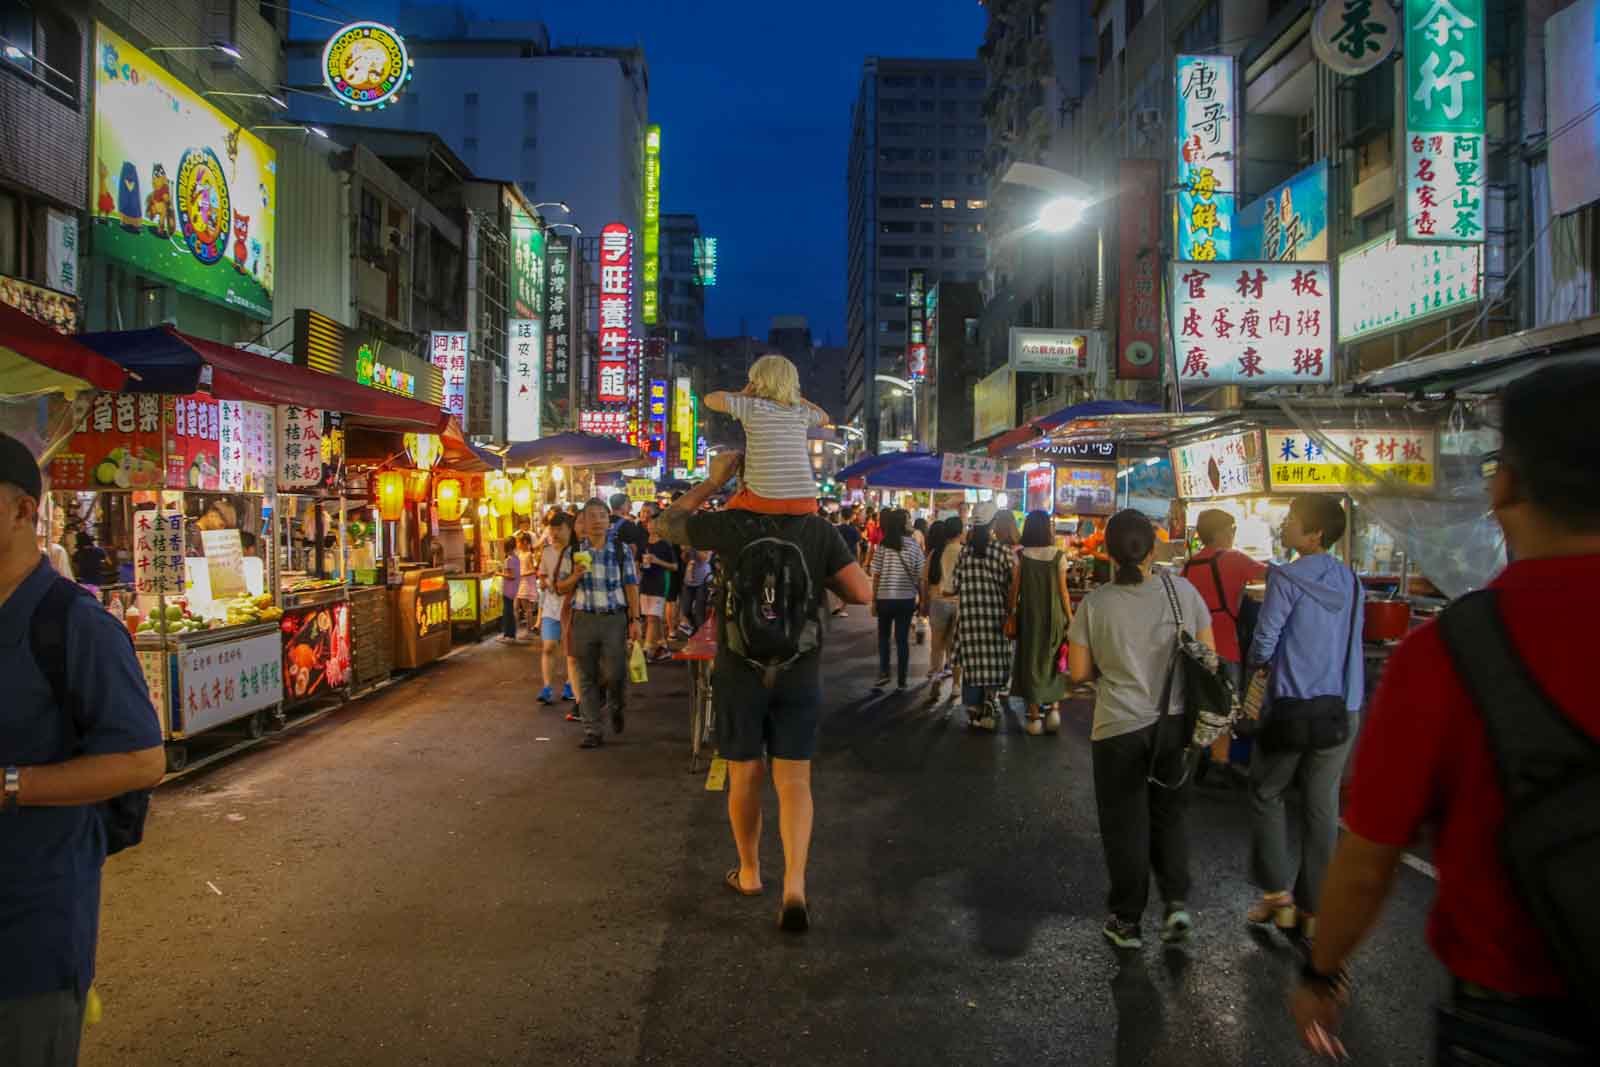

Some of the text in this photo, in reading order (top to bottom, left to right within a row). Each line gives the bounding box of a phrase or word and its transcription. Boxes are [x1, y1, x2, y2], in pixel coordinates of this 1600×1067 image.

[1182, 62, 1229, 144] 唐哥
[1411, 136, 1442, 154] 台灣
[1415, 159, 1439, 235] 名家壺
[1451, 136, 1482, 237] 阿里山茶
[1181, 268, 1322, 299] 官材板
[1180, 306, 1321, 339] 皮蛋瘦肉粥
[450, 335, 465, 430] 紅燒牛肉
[1180, 346, 1323, 378] 廣東粥
[285, 405, 302, 480] 金桔檸檬
[302, 407, 320, 480] 木瓜牛奶
[1348, 437, 1424, 462] 官材板
[137, 514, 152, 592] 木瓜牛奶
[168, 514, 184, 592] 百香果汁
[188, 676, 235, 716] 木瓜牛奶
